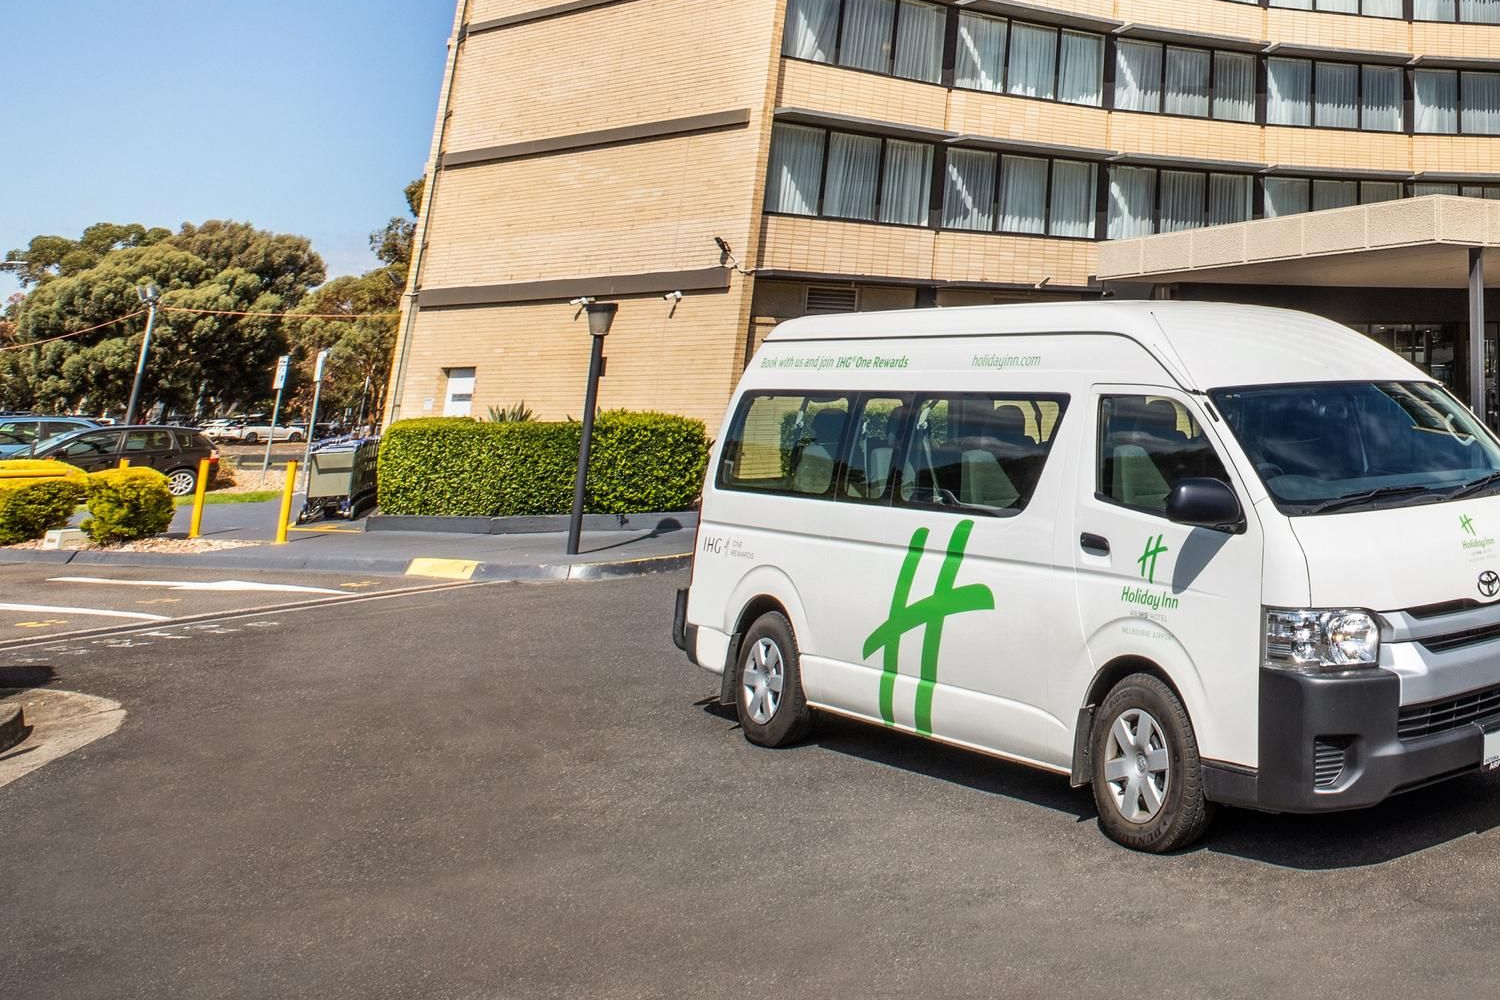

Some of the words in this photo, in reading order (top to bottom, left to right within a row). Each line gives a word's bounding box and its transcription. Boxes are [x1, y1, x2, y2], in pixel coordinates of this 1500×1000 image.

[761, 356, 778, 368] Book
[779, 356, 795, 368] with
[795, 359, 804, 368] us
[804, 356, 820, 368] and
[818, 356, 835, 371] join
[856, 356, 872, 368] One
[873, 355, 909, 368] Rewards
[971, 353, 1041, 370] holidayinn.com
[703, 536, 722, 554] IHG
[1462, 539, 1485, 549] Holiday
[1121, 585, 1161, 610] Holiday
[1161, 591, 1179, 609] Inn
